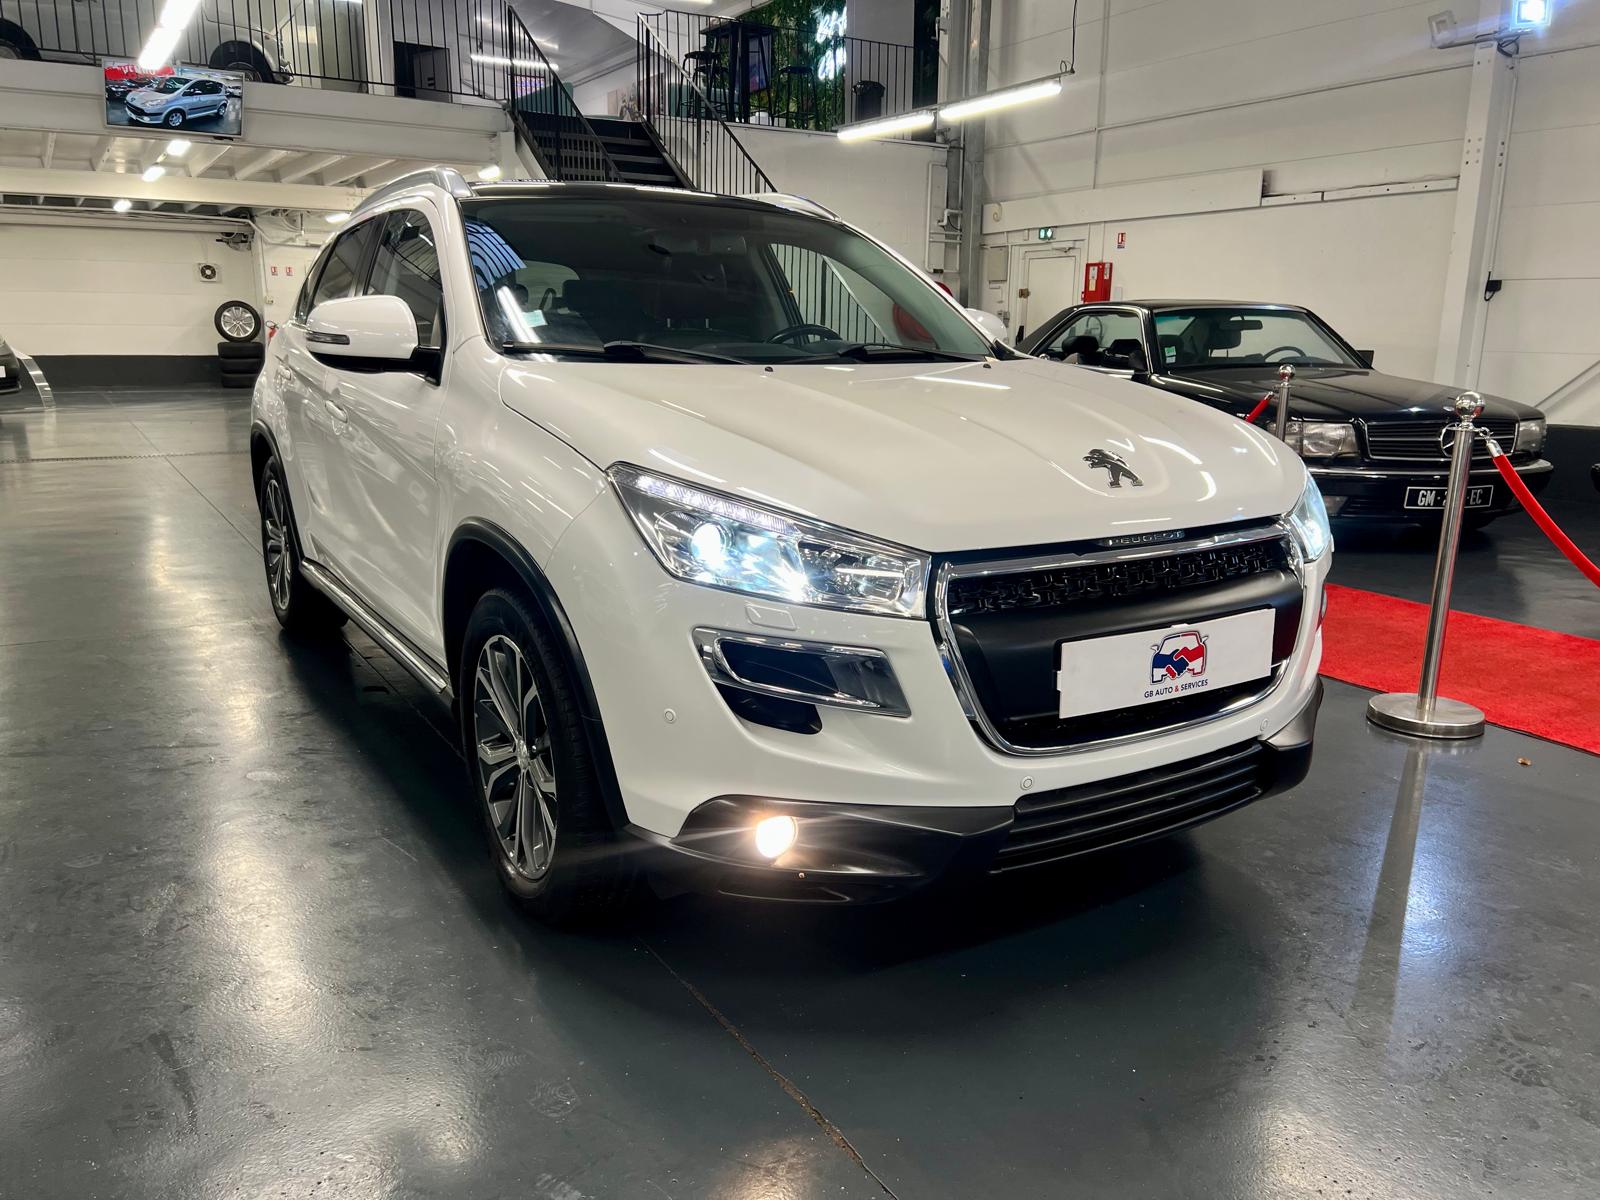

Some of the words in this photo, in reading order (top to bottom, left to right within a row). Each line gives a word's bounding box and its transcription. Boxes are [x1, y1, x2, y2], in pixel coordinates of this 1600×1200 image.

[1144, 690, 1154, 698] GB
[1155, 686, 1173, 696] AUTO
[1180, 679, 1209, 691] SERVICES
